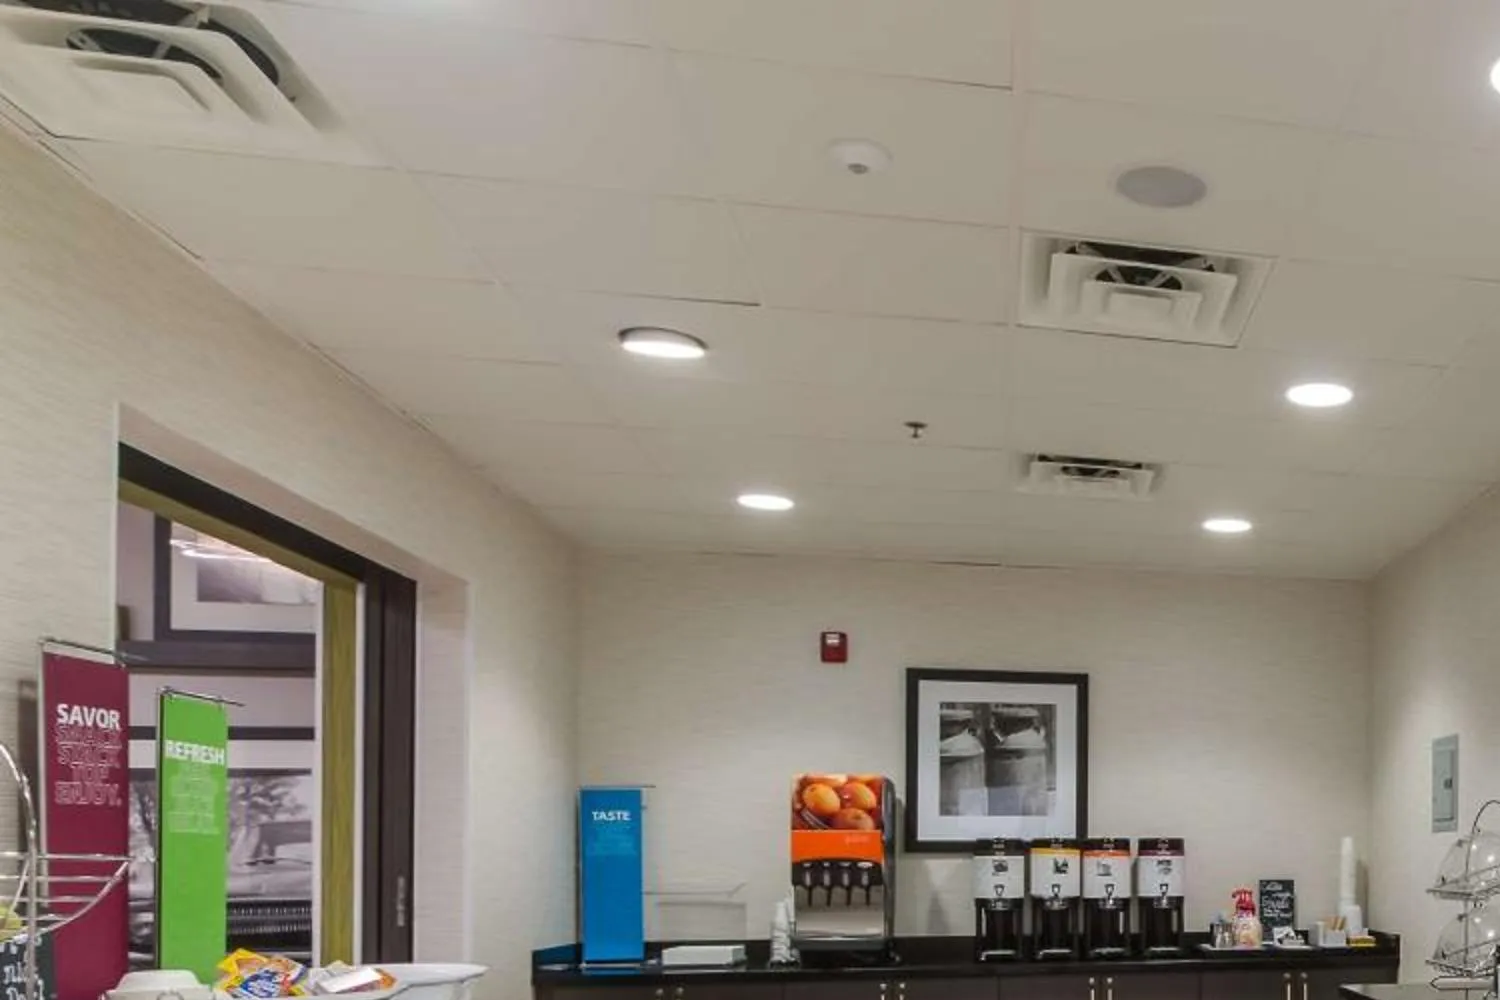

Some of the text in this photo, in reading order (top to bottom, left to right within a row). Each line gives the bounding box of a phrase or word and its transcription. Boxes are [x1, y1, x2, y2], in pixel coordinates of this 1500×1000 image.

[57, 703, 121, 730] SAVOR
[165, 740, 224, 766] REFRESH
[591, 810, 632, 821] TASTE
